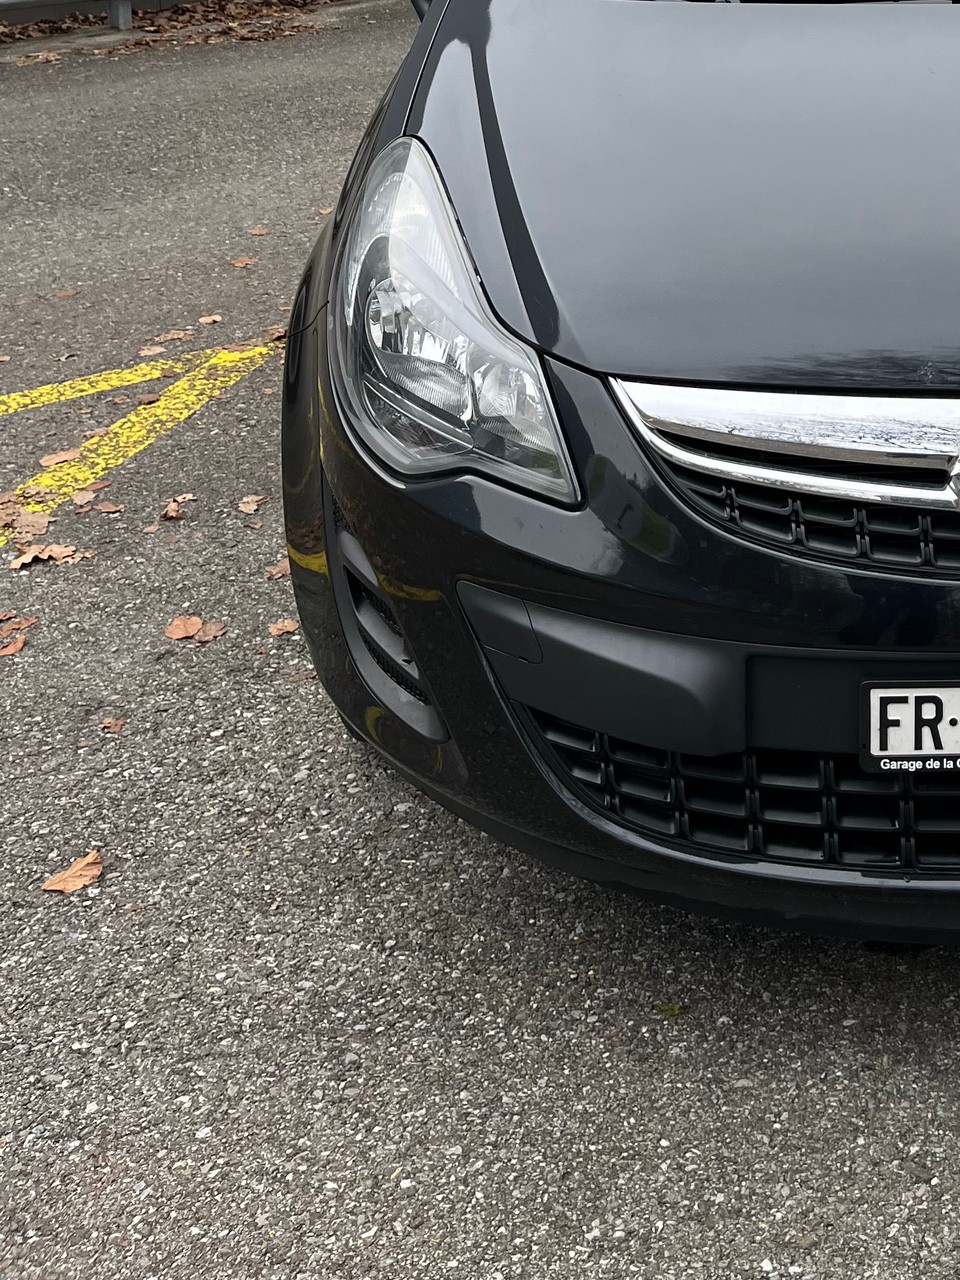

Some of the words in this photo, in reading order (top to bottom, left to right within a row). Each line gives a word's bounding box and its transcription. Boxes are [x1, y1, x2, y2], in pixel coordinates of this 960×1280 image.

[880, 758, 923, 771] Garage
[925, 758, 941, 769] de
[943, 757, 954, 769] la
